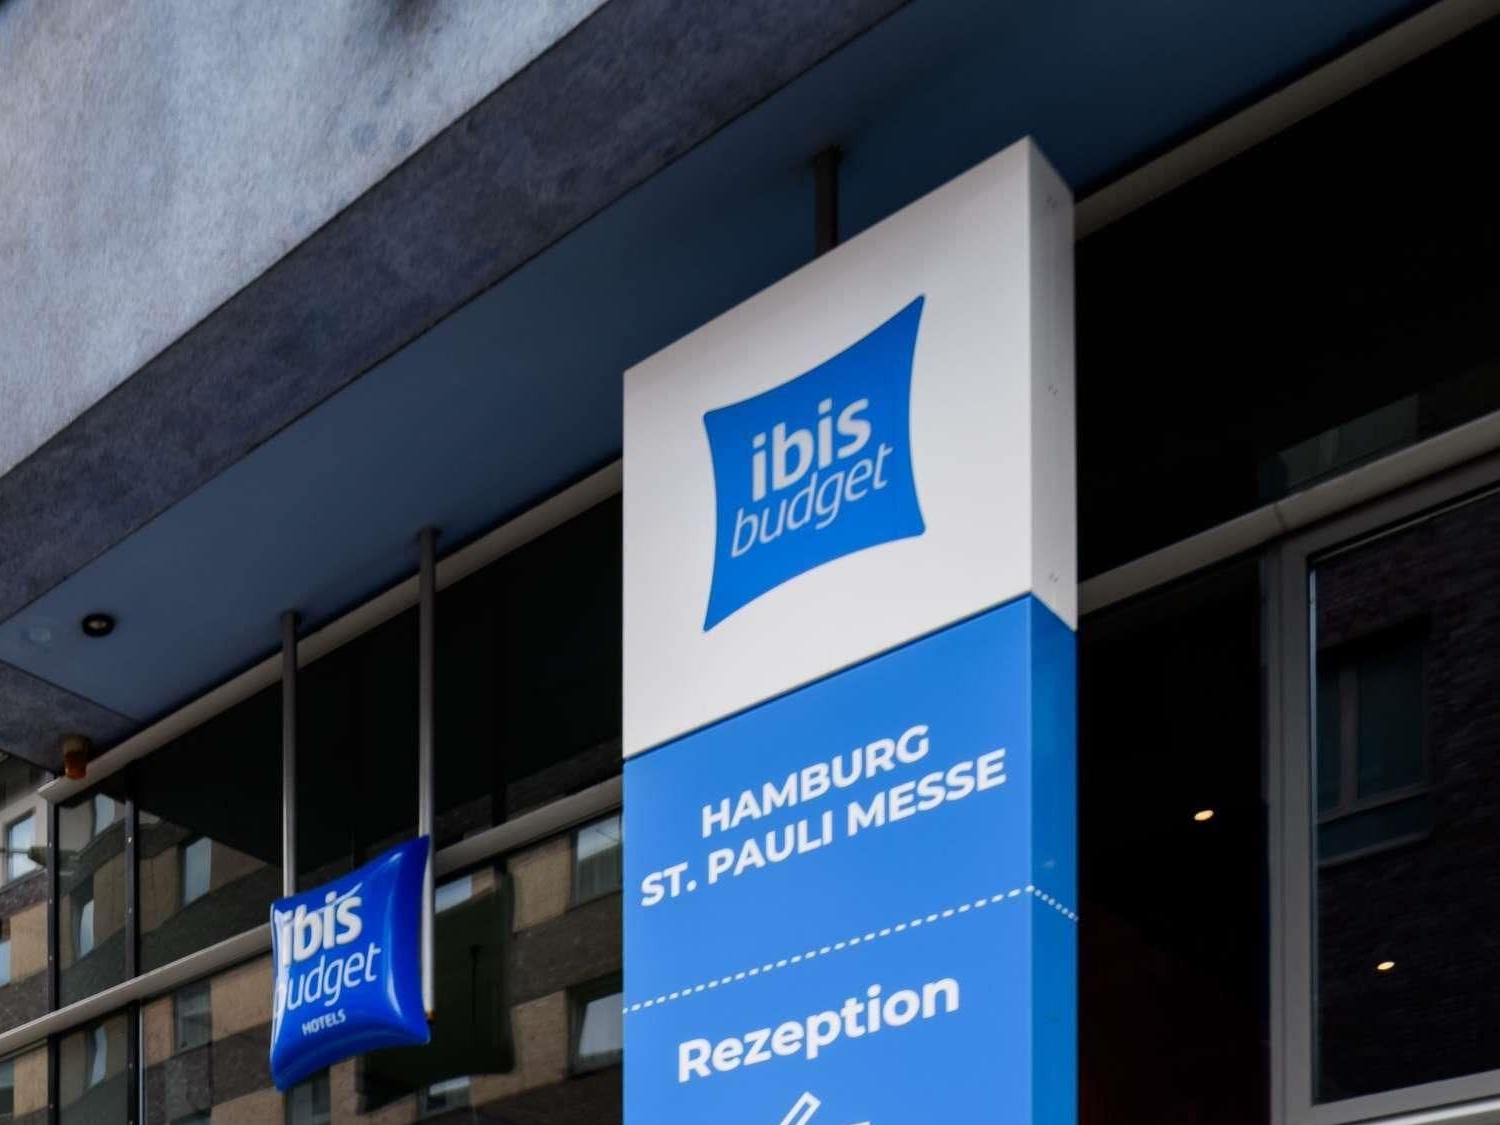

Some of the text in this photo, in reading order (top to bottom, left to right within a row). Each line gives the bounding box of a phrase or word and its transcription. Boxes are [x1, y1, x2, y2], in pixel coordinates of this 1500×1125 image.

[730, 443, 894, 559] budget
[751, 396, 872, 502] ibis
[640, 748, 1007, 907] ST. PAULI MESSE
[701, 724, 930, 839] HAMBURG
[302, 1009, 347, 1036] HOTELS
[678, 977, 960, 1084] Rezeption
